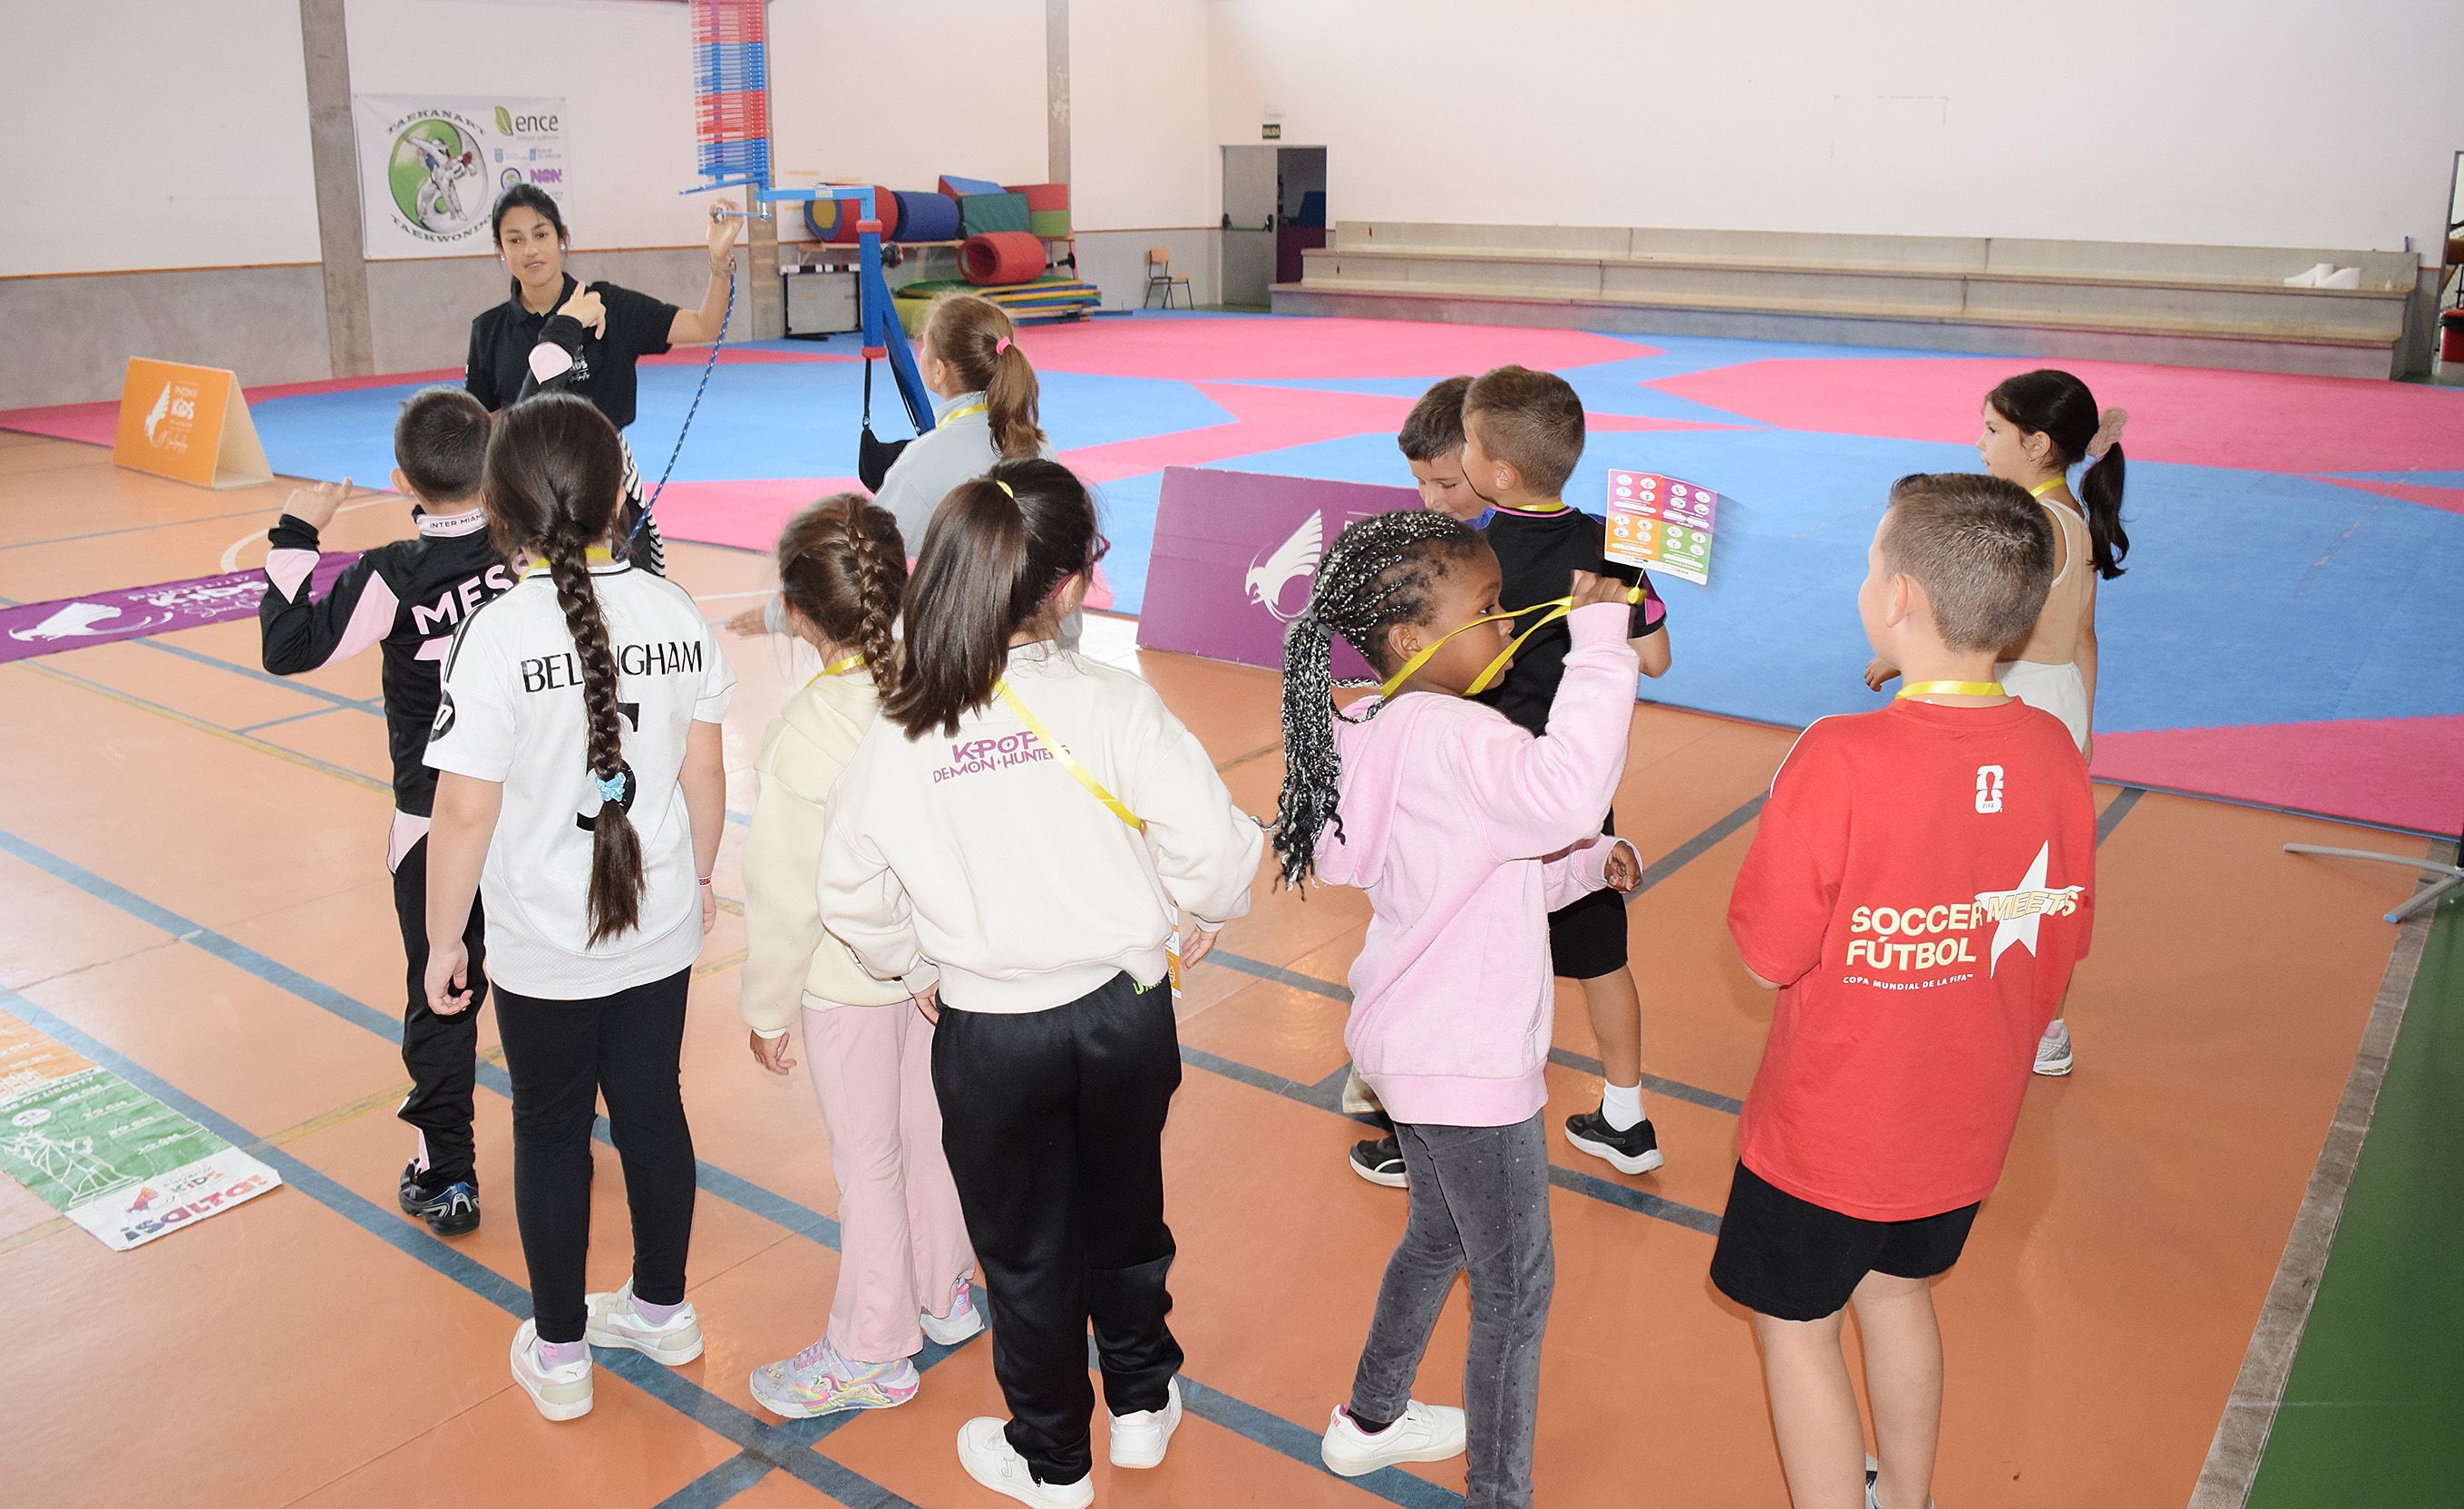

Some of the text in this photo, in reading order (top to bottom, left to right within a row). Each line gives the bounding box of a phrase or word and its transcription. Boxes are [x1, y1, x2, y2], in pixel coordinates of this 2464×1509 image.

[515, 115, 559, 132] ence
[430, 514, 482, 529] INTER MIAM
[520, 640, 702, 693] BELGHAM
[932, 755, 996, 784] DEMON
[1850, 890, 2079, 936] SOCCER MEETS
[1846, 936, 1977, 971] FÚTBOL
[1843, 976, 1869, 986] COPA
[1873, 979, 1920, 990] MUNDIAL
[1923, 979, 1934, 988] DE
[1936, 978, 1948, 986] LA
